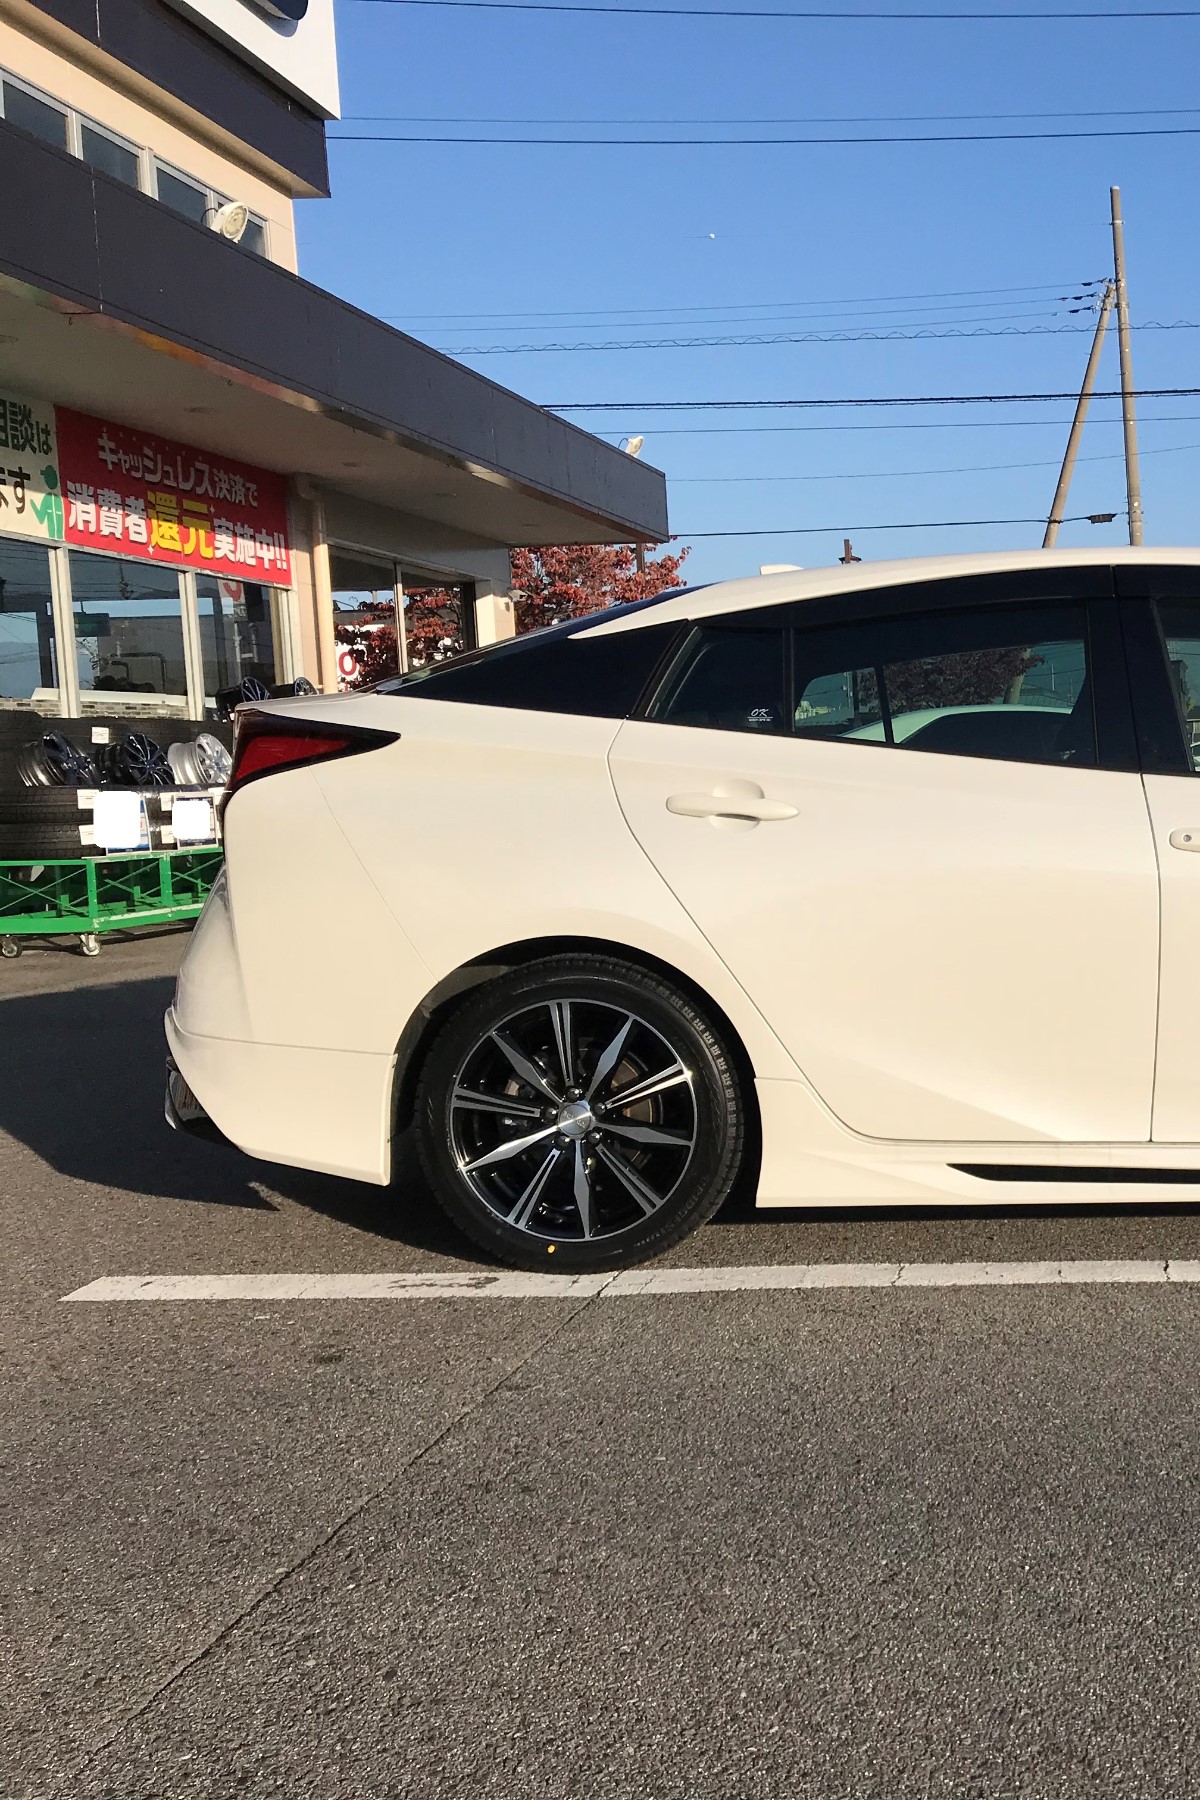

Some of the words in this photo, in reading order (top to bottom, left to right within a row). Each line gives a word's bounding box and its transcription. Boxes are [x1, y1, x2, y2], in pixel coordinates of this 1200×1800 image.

[98, 433, 258, 508] キャッシュレス決済で
